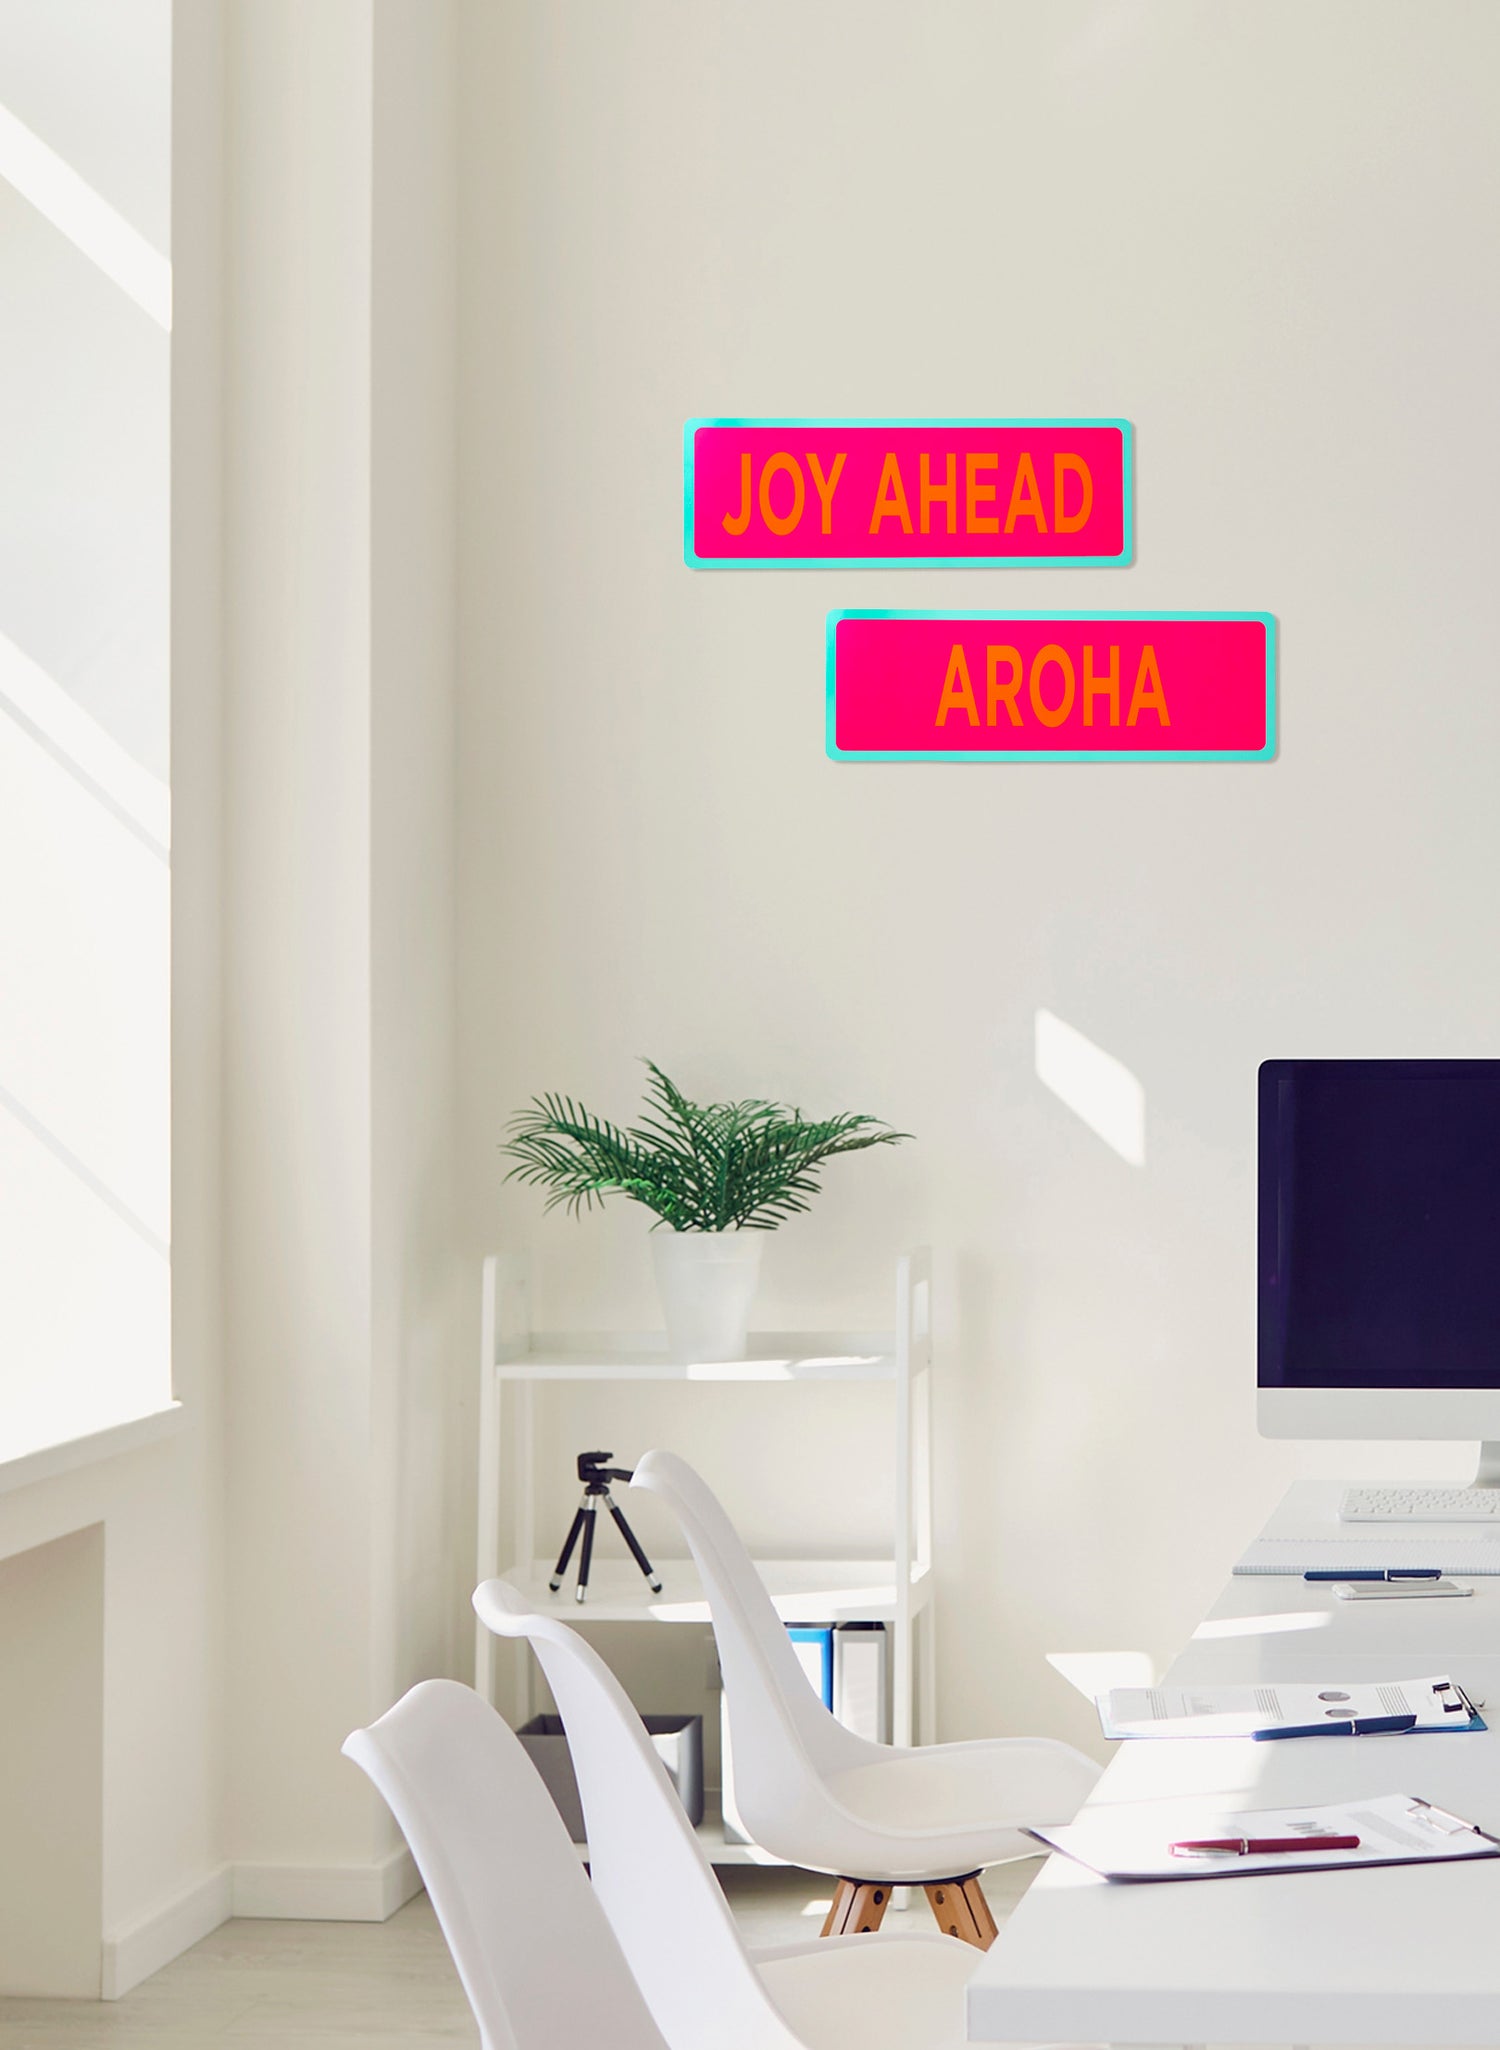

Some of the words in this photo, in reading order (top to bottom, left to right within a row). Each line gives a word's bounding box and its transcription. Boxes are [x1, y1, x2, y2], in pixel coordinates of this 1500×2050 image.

[721, 452, 848, 536] JOY
[868, 452, 1093, 535] AHEAD
[935, 644, 1171, 728] AROHA
